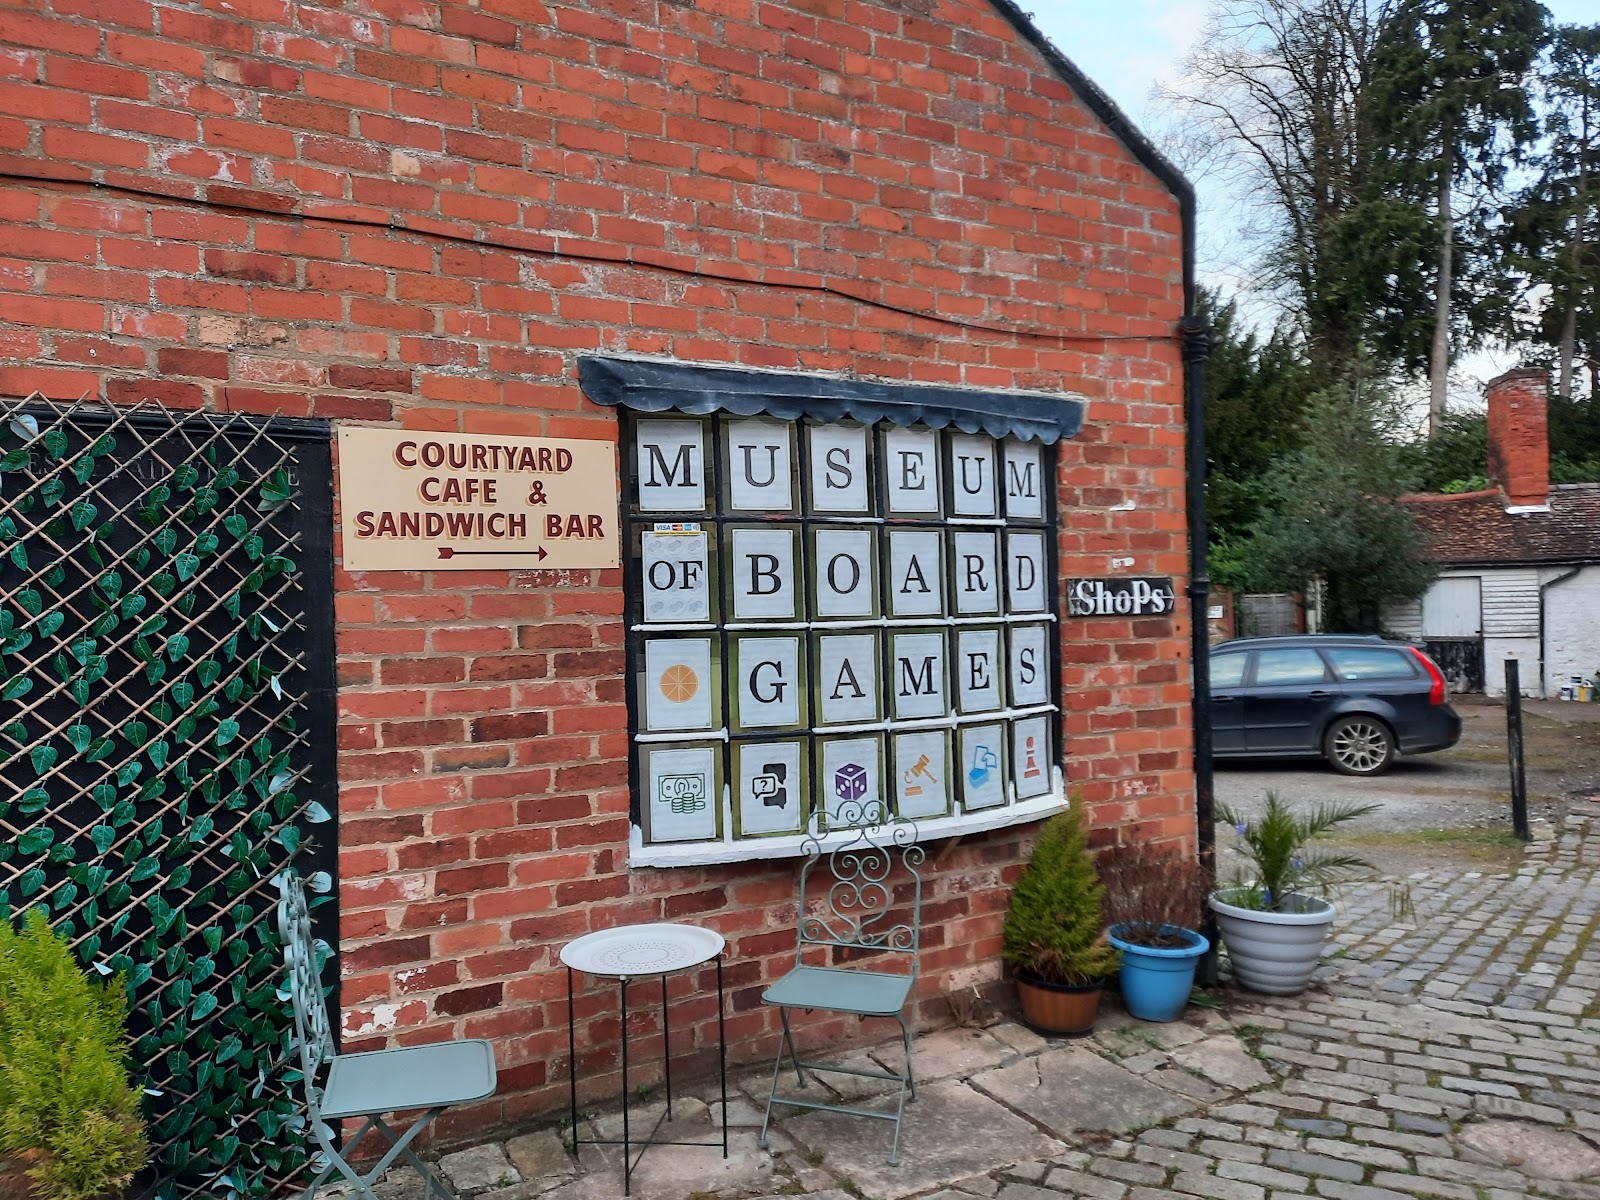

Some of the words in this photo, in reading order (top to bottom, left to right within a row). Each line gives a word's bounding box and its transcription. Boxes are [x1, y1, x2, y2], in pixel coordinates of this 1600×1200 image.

[394, 441, 573, 472] COURTYARD
[642, 444, 1037, 498] MUSEUM
[419, 477, 498, 504] CAFE
[527, 480, 548, 505] &
[355, 511, 527, 538] SANDWICH
[545, 514, 605, 538] BAR
[648, 560, 704, 591] OF
[745, 553, 1036, 596] BOARD
[748, 647, 1037, 704] GAMES
